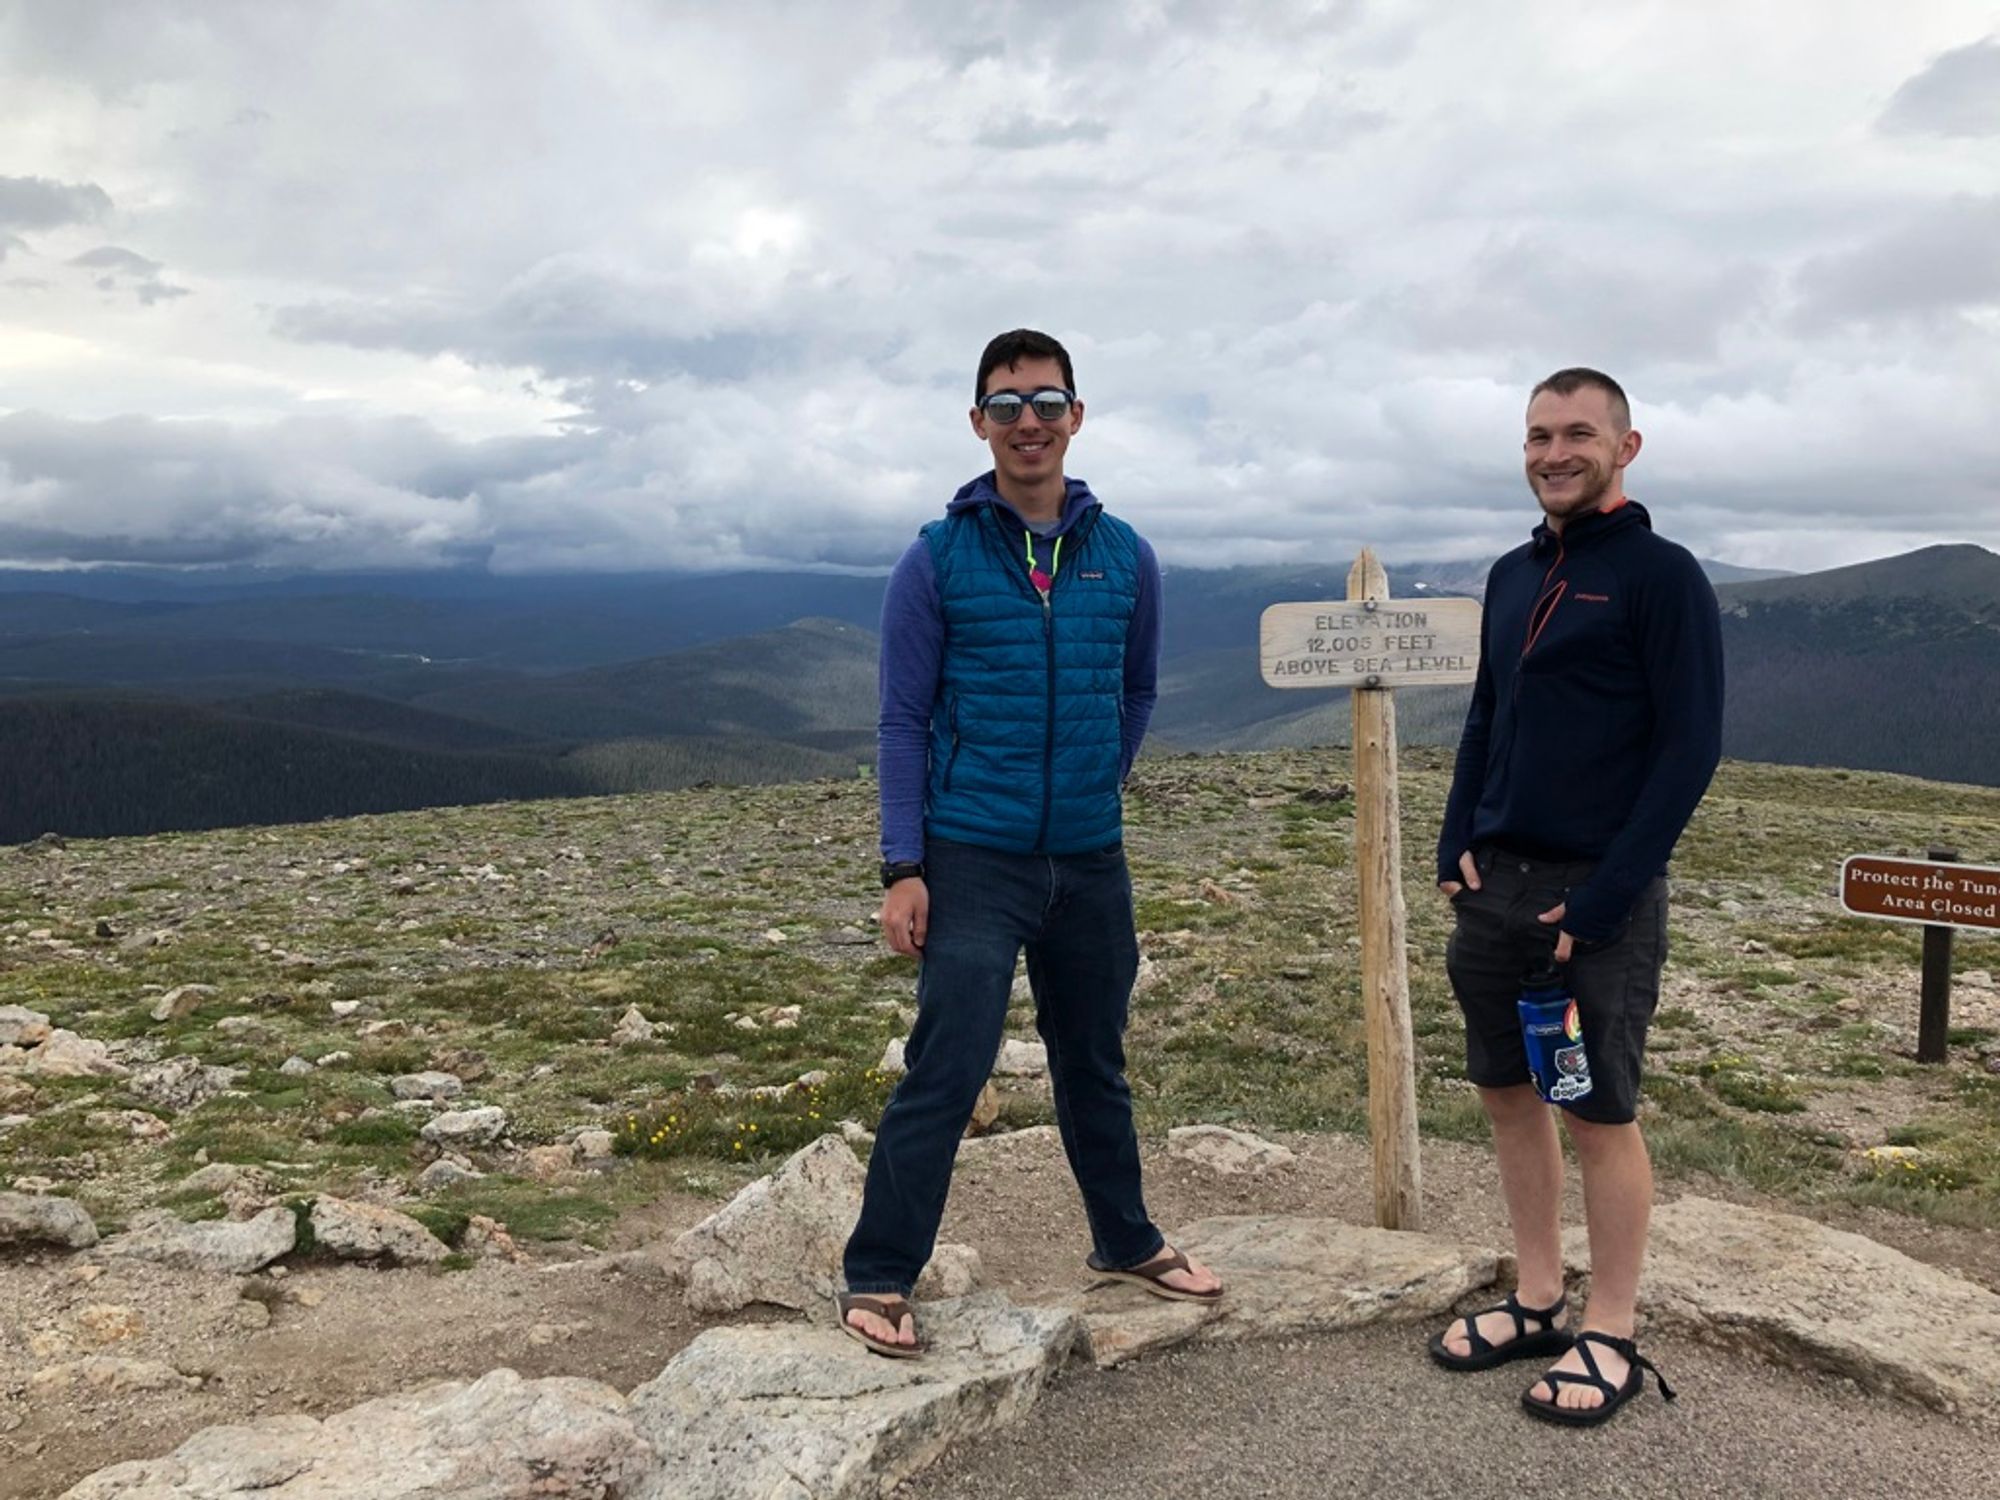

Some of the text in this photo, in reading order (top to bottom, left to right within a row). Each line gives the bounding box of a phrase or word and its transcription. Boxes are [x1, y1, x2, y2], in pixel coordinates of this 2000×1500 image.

[1315, 612, 1428, 631] ELEVATION
[1306, 634, 1437, 654] 12,005 FEET
[1274, 655, 1472, 675] ABOVE SEA LEVEL
[1851, 868, 2000, 896] Protect the Tun
[1882, 893, 1996, 918] Area Closed
